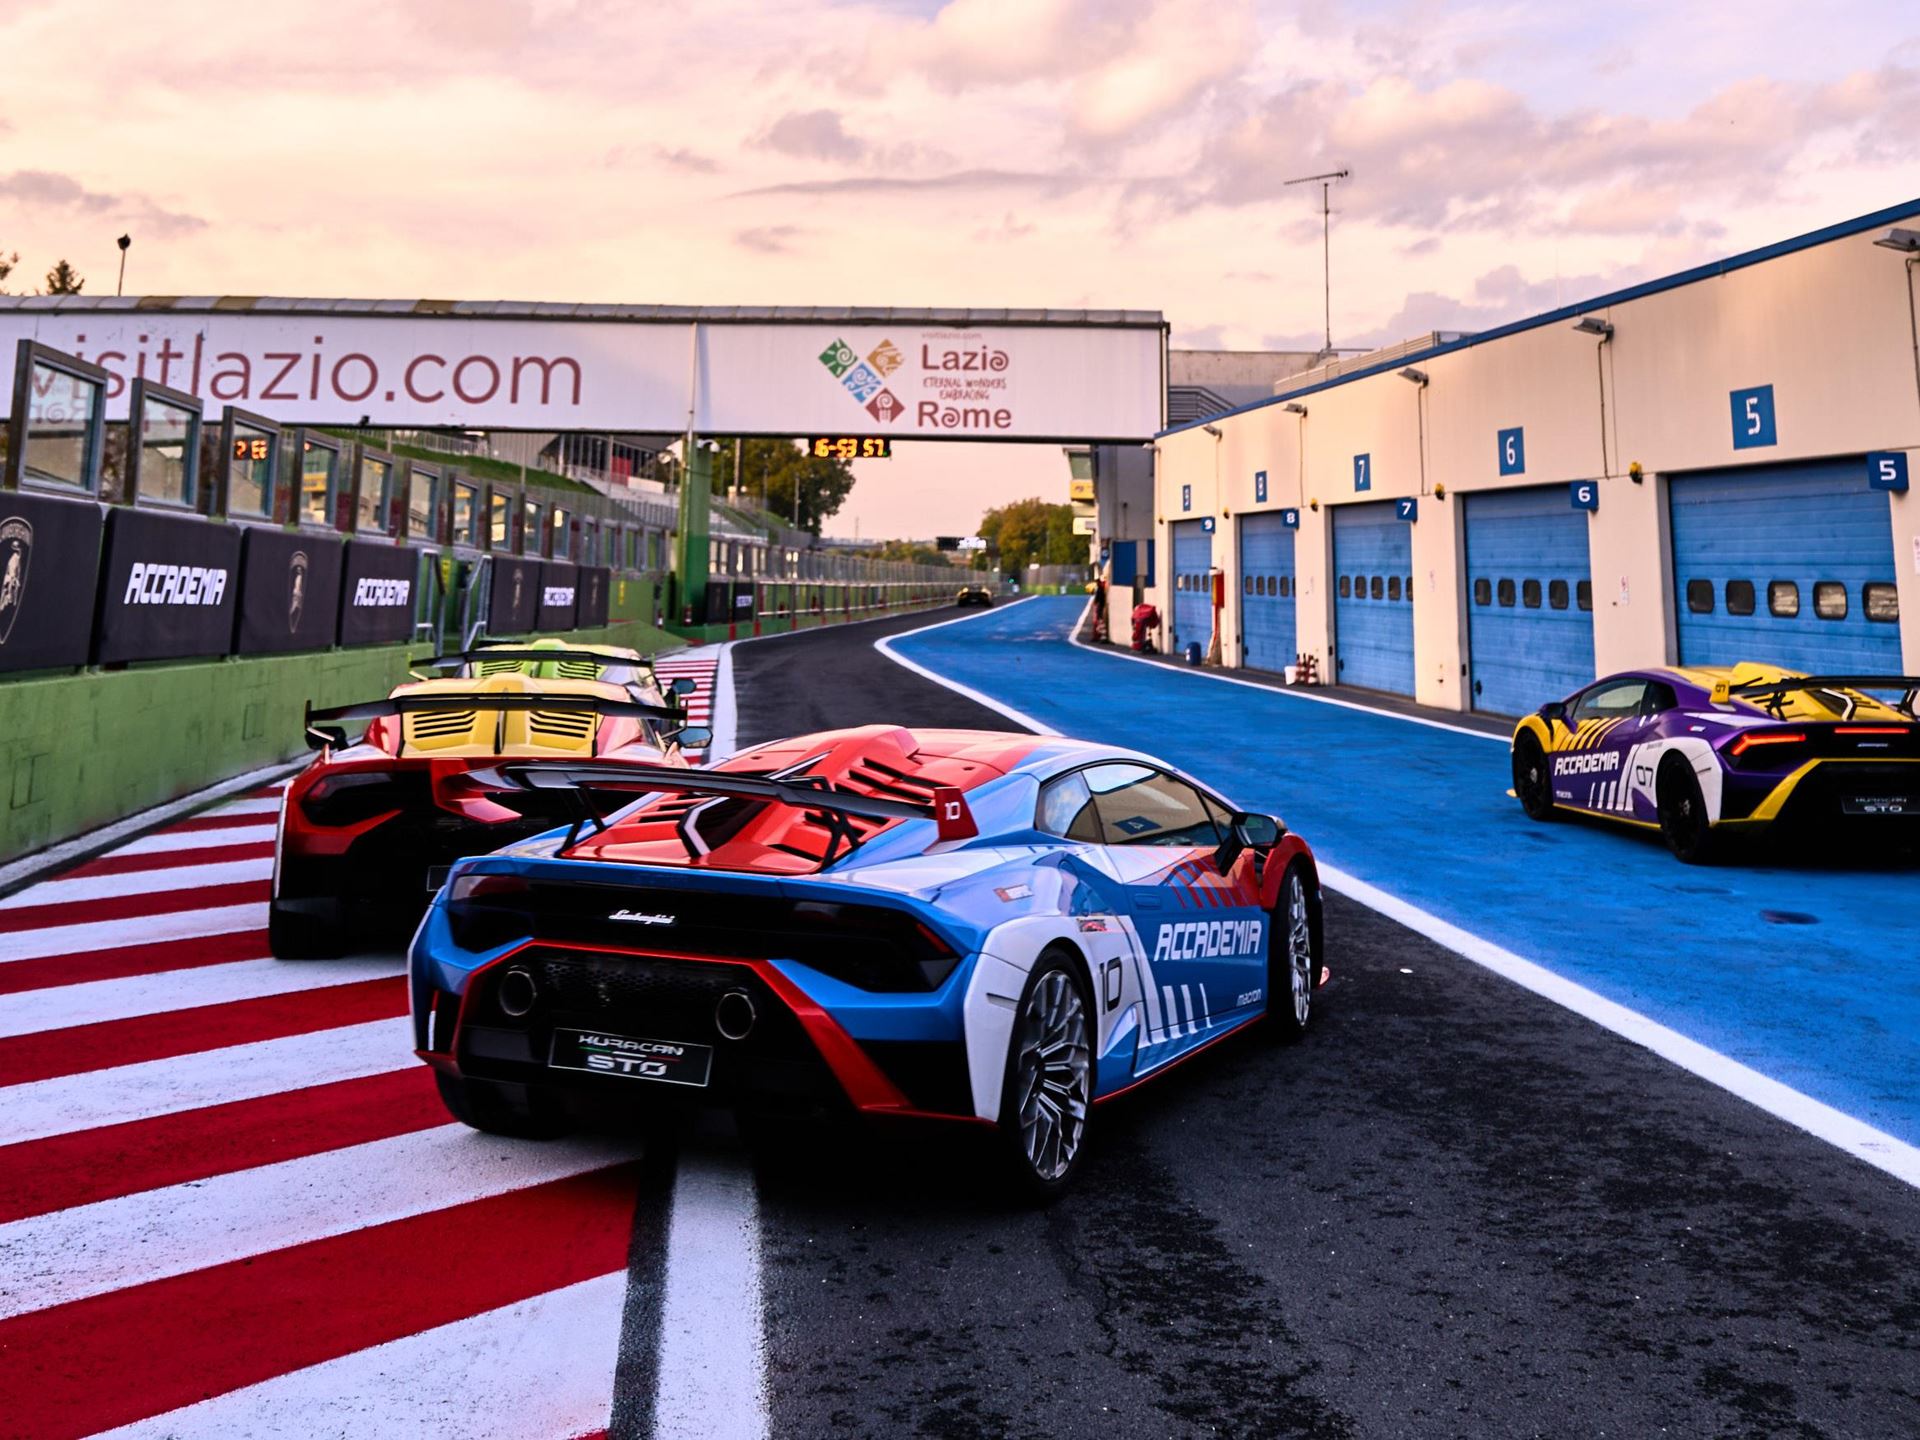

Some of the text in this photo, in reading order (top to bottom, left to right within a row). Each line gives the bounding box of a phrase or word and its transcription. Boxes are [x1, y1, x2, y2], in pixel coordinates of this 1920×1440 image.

[922, 343, 1009, 372] Lazio
[917, 400, 1012, 428] Rome
[1746, 397, 1761, 435] 5
[1505, 436, 1516, 466] 6
[1358, 459, 1366, 484] 7
[1879, 460, 1897, 480] 5
[1578, 486, 1591, 502] 6
[1286, 512, 1296, 524] 8
[1401, 502, 1412, 515] 7
[1204, 519, 1213, 530] 9
[124, 563, 228, 605] ACCADEMIA
[353, 578, 410, 606] ACCADEMIA
[1554, 751, 1620, 776] ACCADEMIA
[1636, 765, 1654, 788] 07
[945, 802, 960, 820] 10
[1153, 920, 1262, 962] ACCADEMIA
[1099, 956, 1122, 1016] 10
[578, 1035, 684, 1055] HURACAN
[587, 1054, 667, 1077] STO
